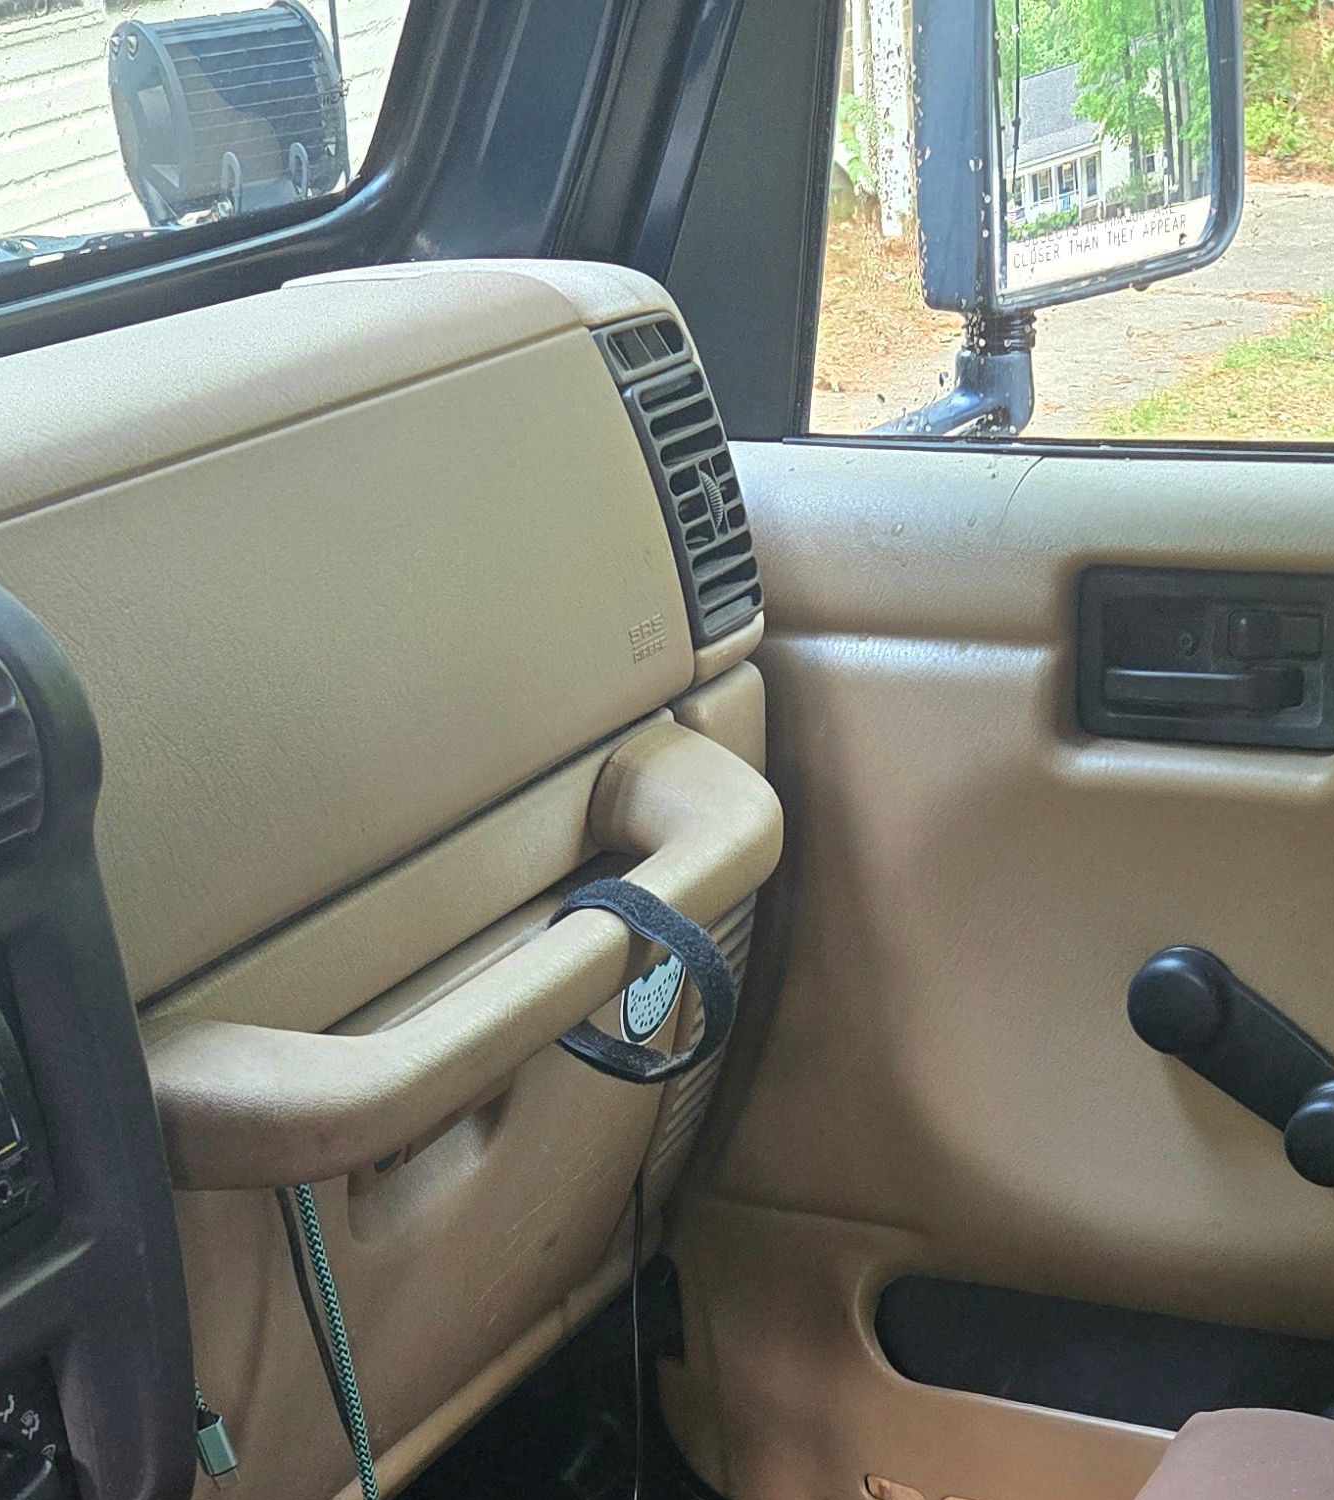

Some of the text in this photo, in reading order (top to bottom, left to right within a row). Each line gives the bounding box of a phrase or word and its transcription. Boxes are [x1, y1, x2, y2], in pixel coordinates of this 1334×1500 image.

[1013, 213, 1187, 269] CLOSER THAN THEY APPEAR
[628, 613, 665, 645] SRS
